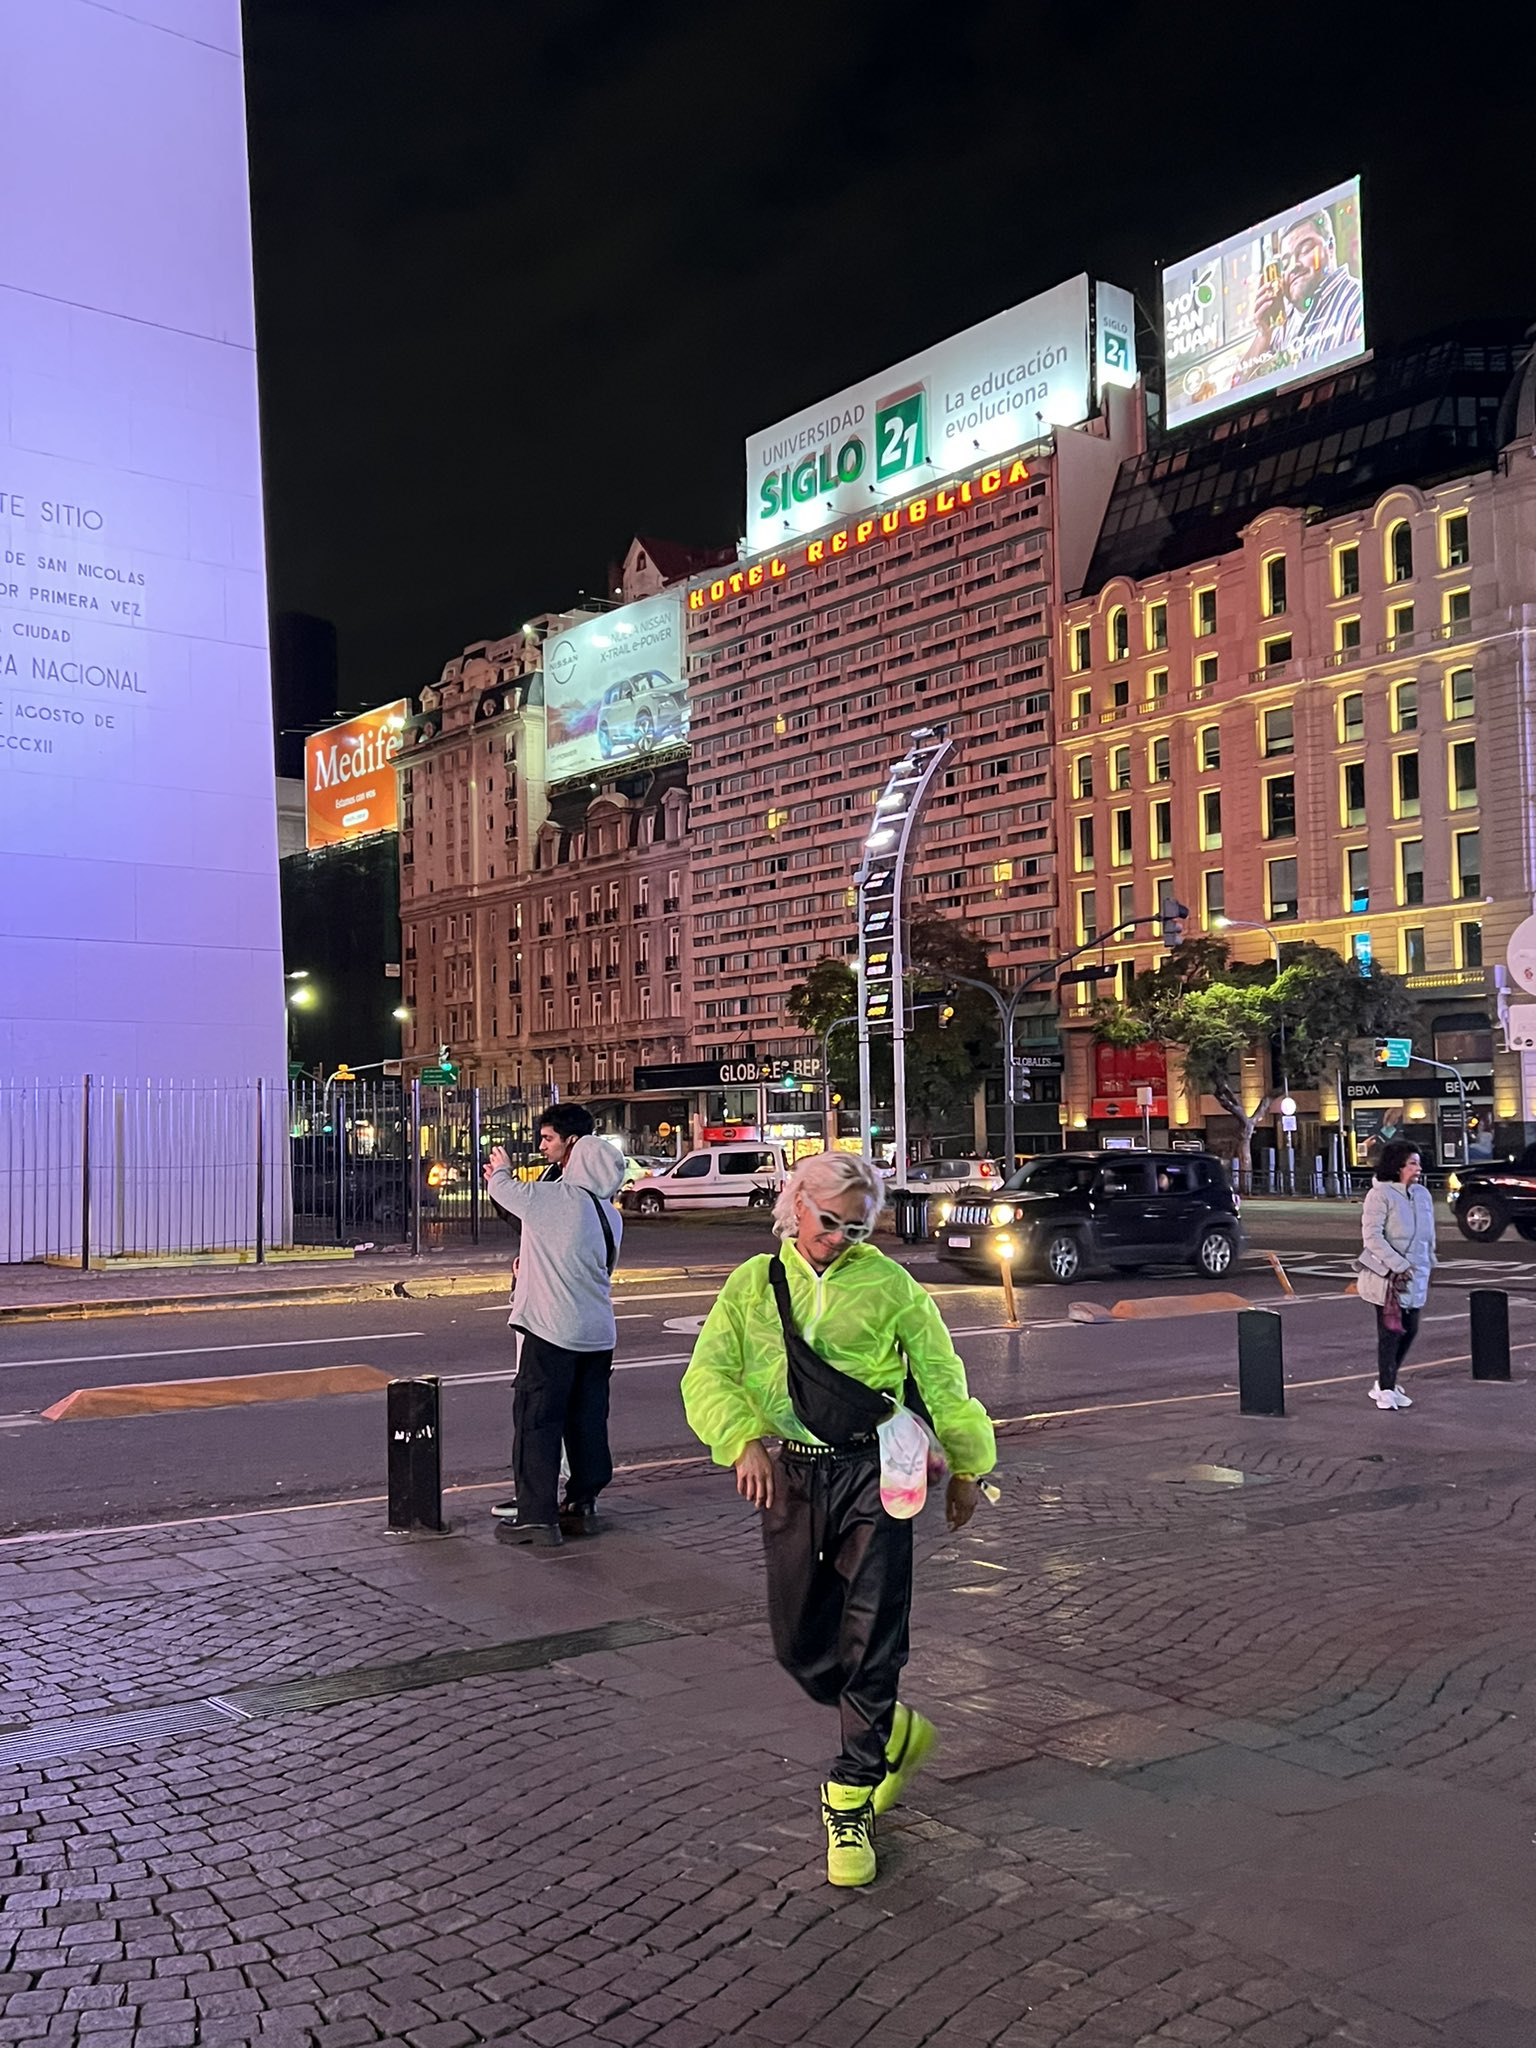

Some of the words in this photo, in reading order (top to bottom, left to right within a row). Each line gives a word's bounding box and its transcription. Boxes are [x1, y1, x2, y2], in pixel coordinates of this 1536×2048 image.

[1103, 316, 1128, 334] SIGLO
[1105, 338, 1127, 369] 21
[945, 391, 965, 414] La
[970, 345, 1068, 400] educación
[945, 381, 1049, 439] evoluciona
[762, 404, 865, 467] UNIVERSIDAD
[760, 434, 866, 519] SIGLO
[881, 416, 918, 470] 21
[41, 501, 103, 530] SITIO
[689, 557, 787, 611] HOTEL
[807, 459, 1029, 565] REPUBLICA
[5, 550, 26, 566] DE
[37, 556, 67, 573] SAN
[78, 563, 145, 586] NICOLAS
[30, 587, 99, 611] PRIMERA
[111, 600, 142, 617] VEZ
[13, 623, 70, 642] CIUDAD
[640, 611, 672, 632] NISSAN
[0, 653, 18, 676] A
[32, 657, 147, 693] NACIONAL
[549, 654, 578, 672] NISSAN
[15, 704, 84, 724] AGOSTO
[95, 714, 115, 729] DE
[720, 1060, 789, 1082] GLOBE
[1347, 1085, 1380, 1096] BBVA
[1445, 1080, 1481, 1093] BBVA
